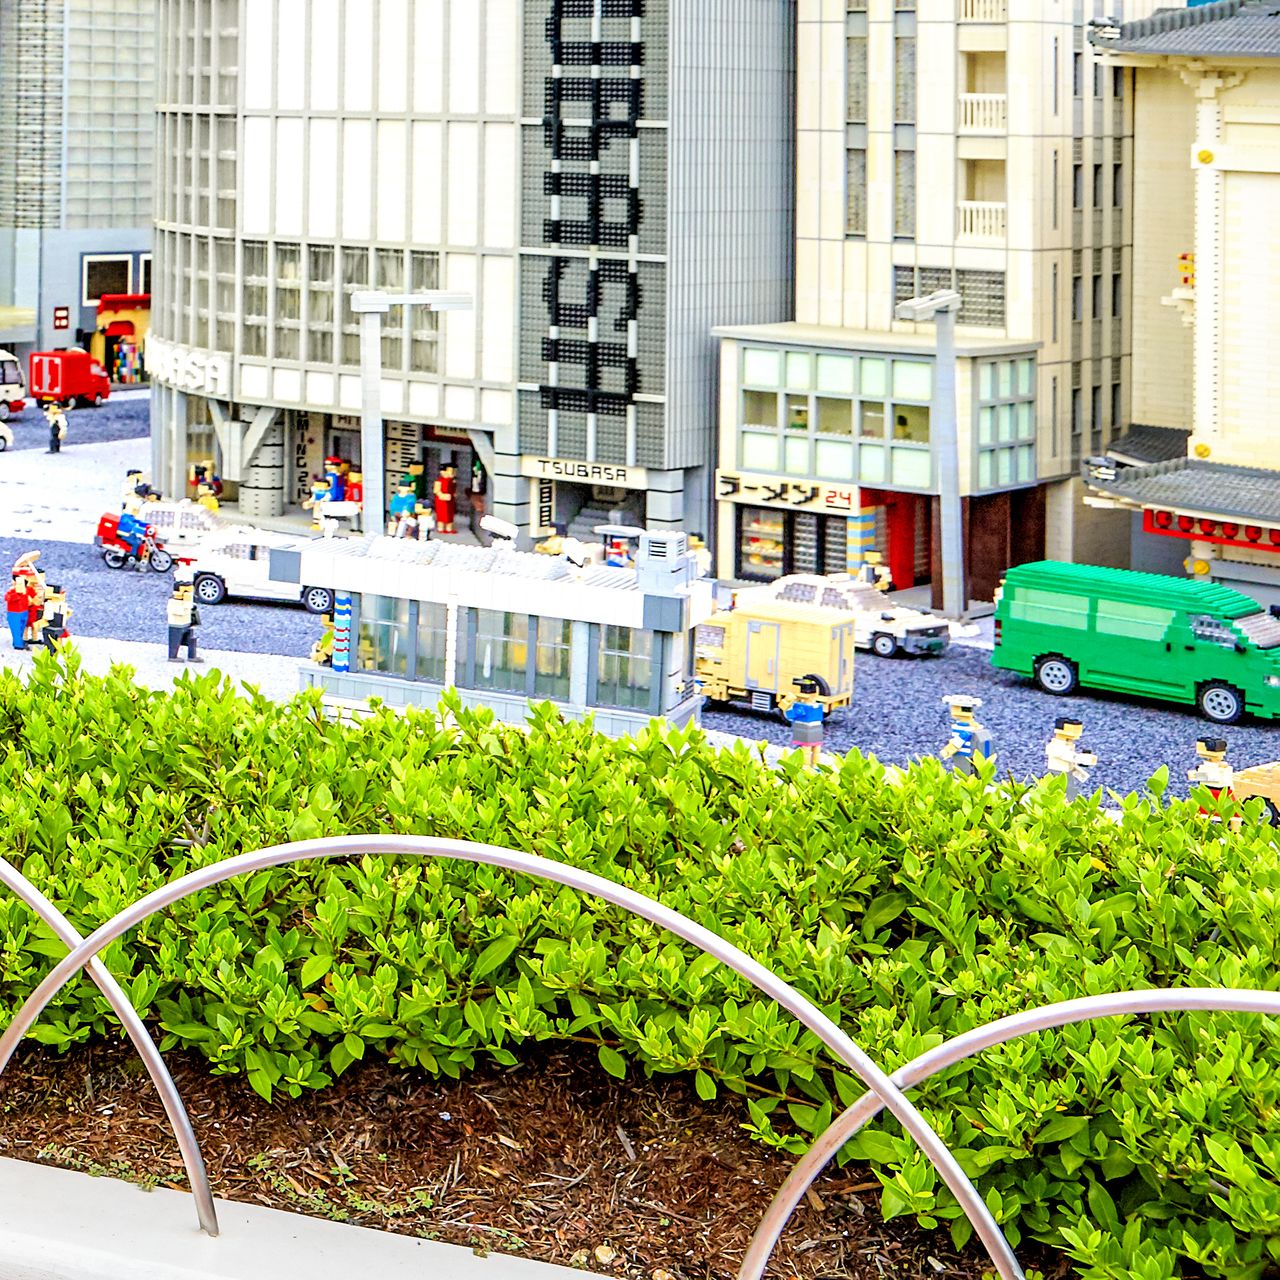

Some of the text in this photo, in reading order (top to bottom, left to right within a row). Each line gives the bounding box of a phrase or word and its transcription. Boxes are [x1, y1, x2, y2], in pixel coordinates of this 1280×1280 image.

[538, 460, 627, 482] TSUBASA
[719, 475, 852, 506] ラーメン 24
